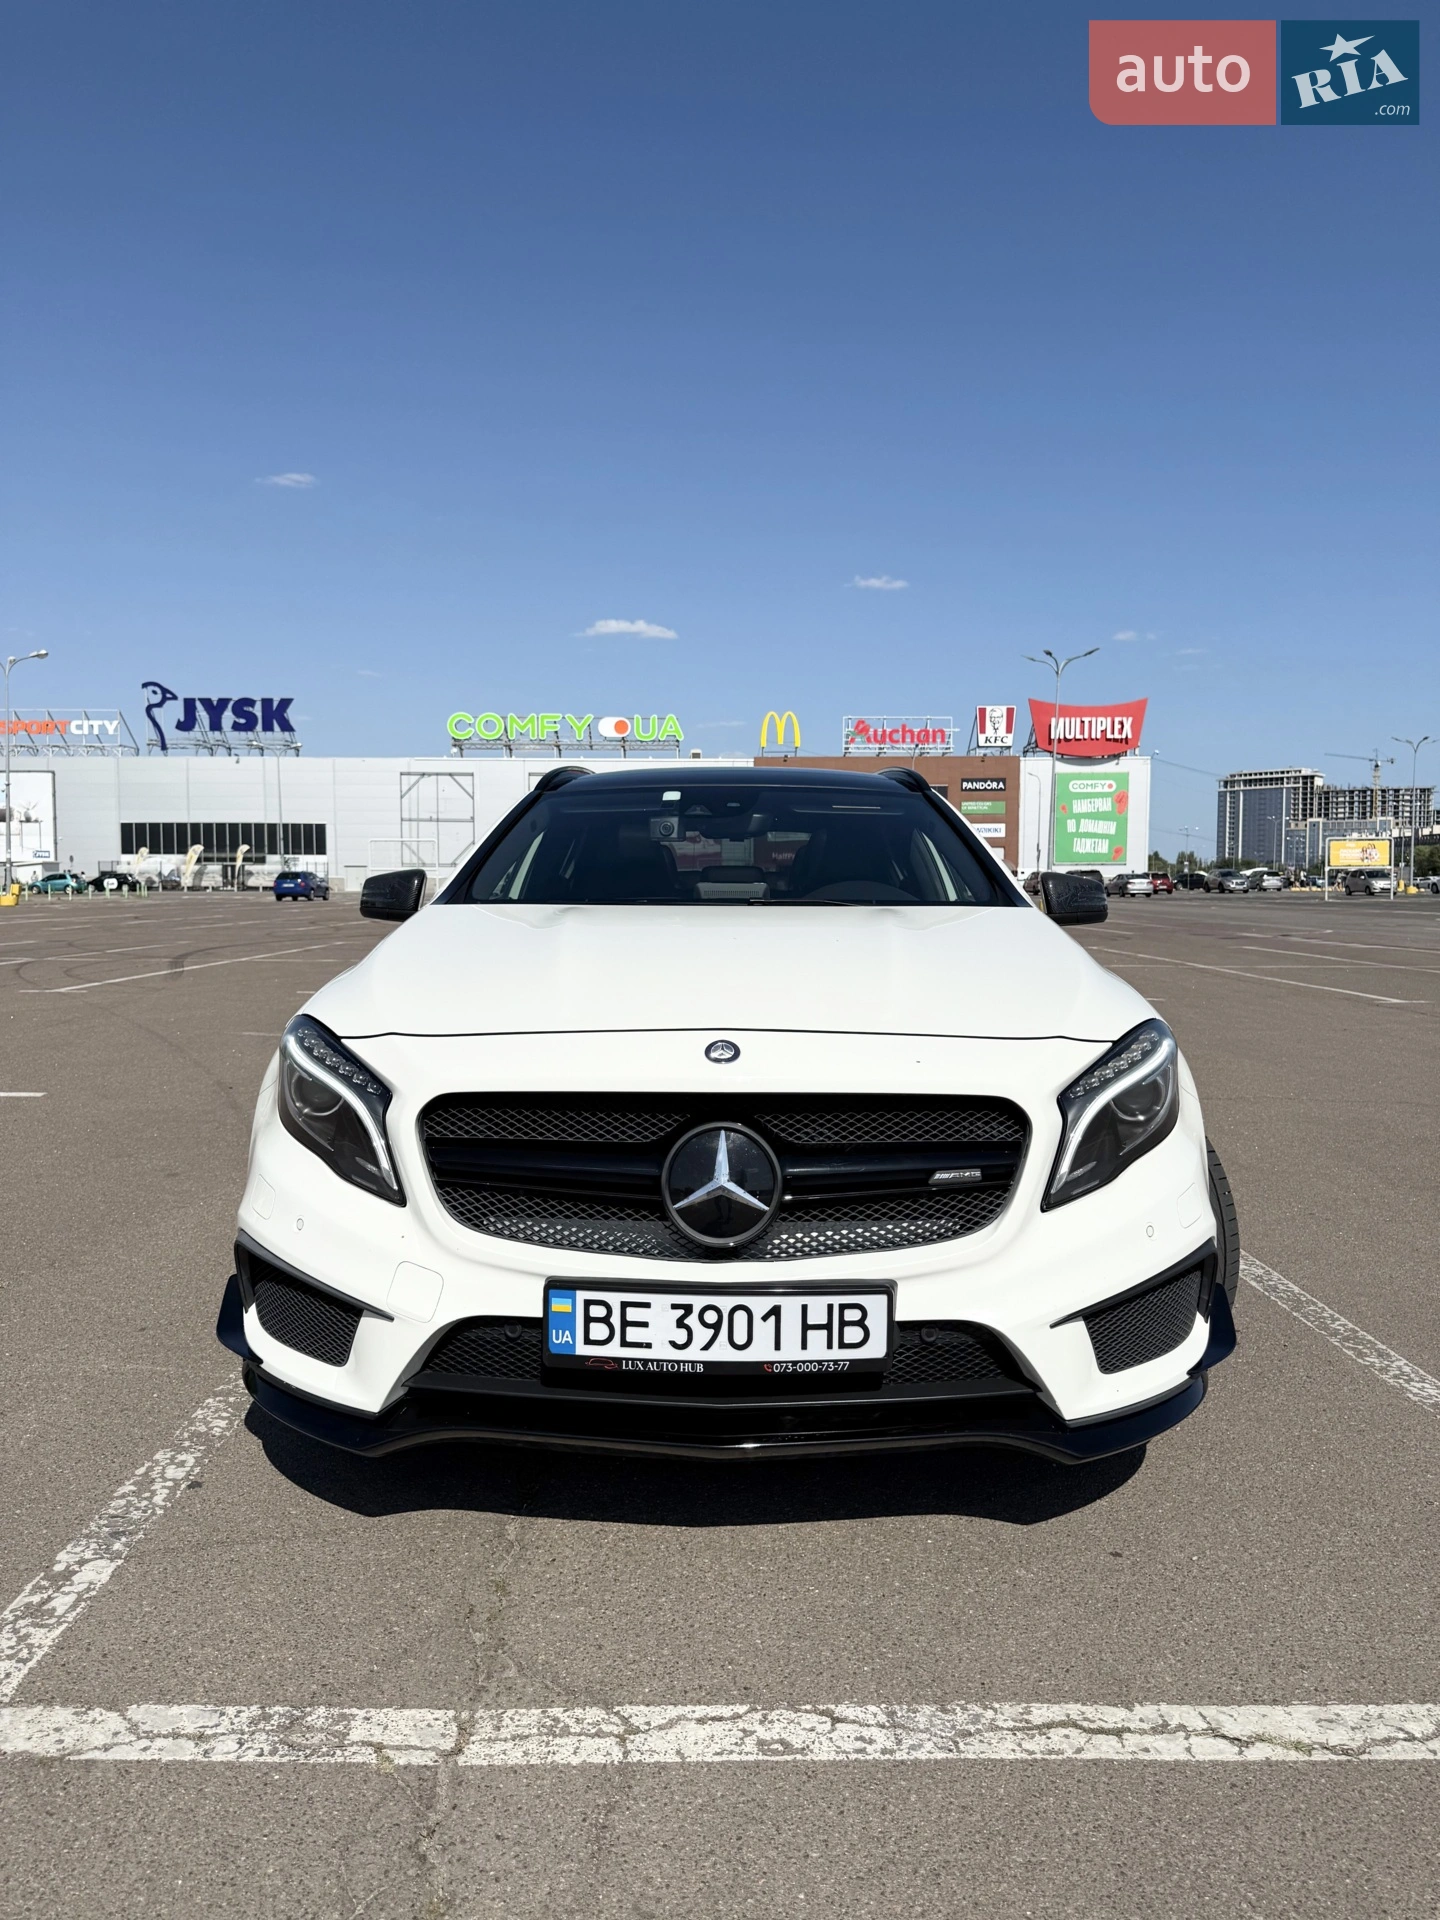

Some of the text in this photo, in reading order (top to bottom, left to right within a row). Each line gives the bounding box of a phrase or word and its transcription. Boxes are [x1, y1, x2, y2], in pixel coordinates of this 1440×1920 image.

[175, 697, 296, 732] JYSK
[447, 712, 684, 741] COMFY UA
[850, 719, 946, 744] Auchan
[1050, 716, 1133, 740] MULTIPLEX
[984, 736, 1009, 744] KFC
[1072, 782, 1107, 790] COMFY
[1072, 797, 1112, 814] НАМБЕРВАН
[1066, 818, 1077, 833] ПО
[1073, 837, 1109, 854] ГАДЖЕТАМ
[583, 1298, 870, 1351] BE 3901 HB
[552, 1329, 573, 1345] UA
[622, 1360, 704, 1373] LUX AUTO HUB
[773, 1361, 850, 1373] 073-000-73-77
